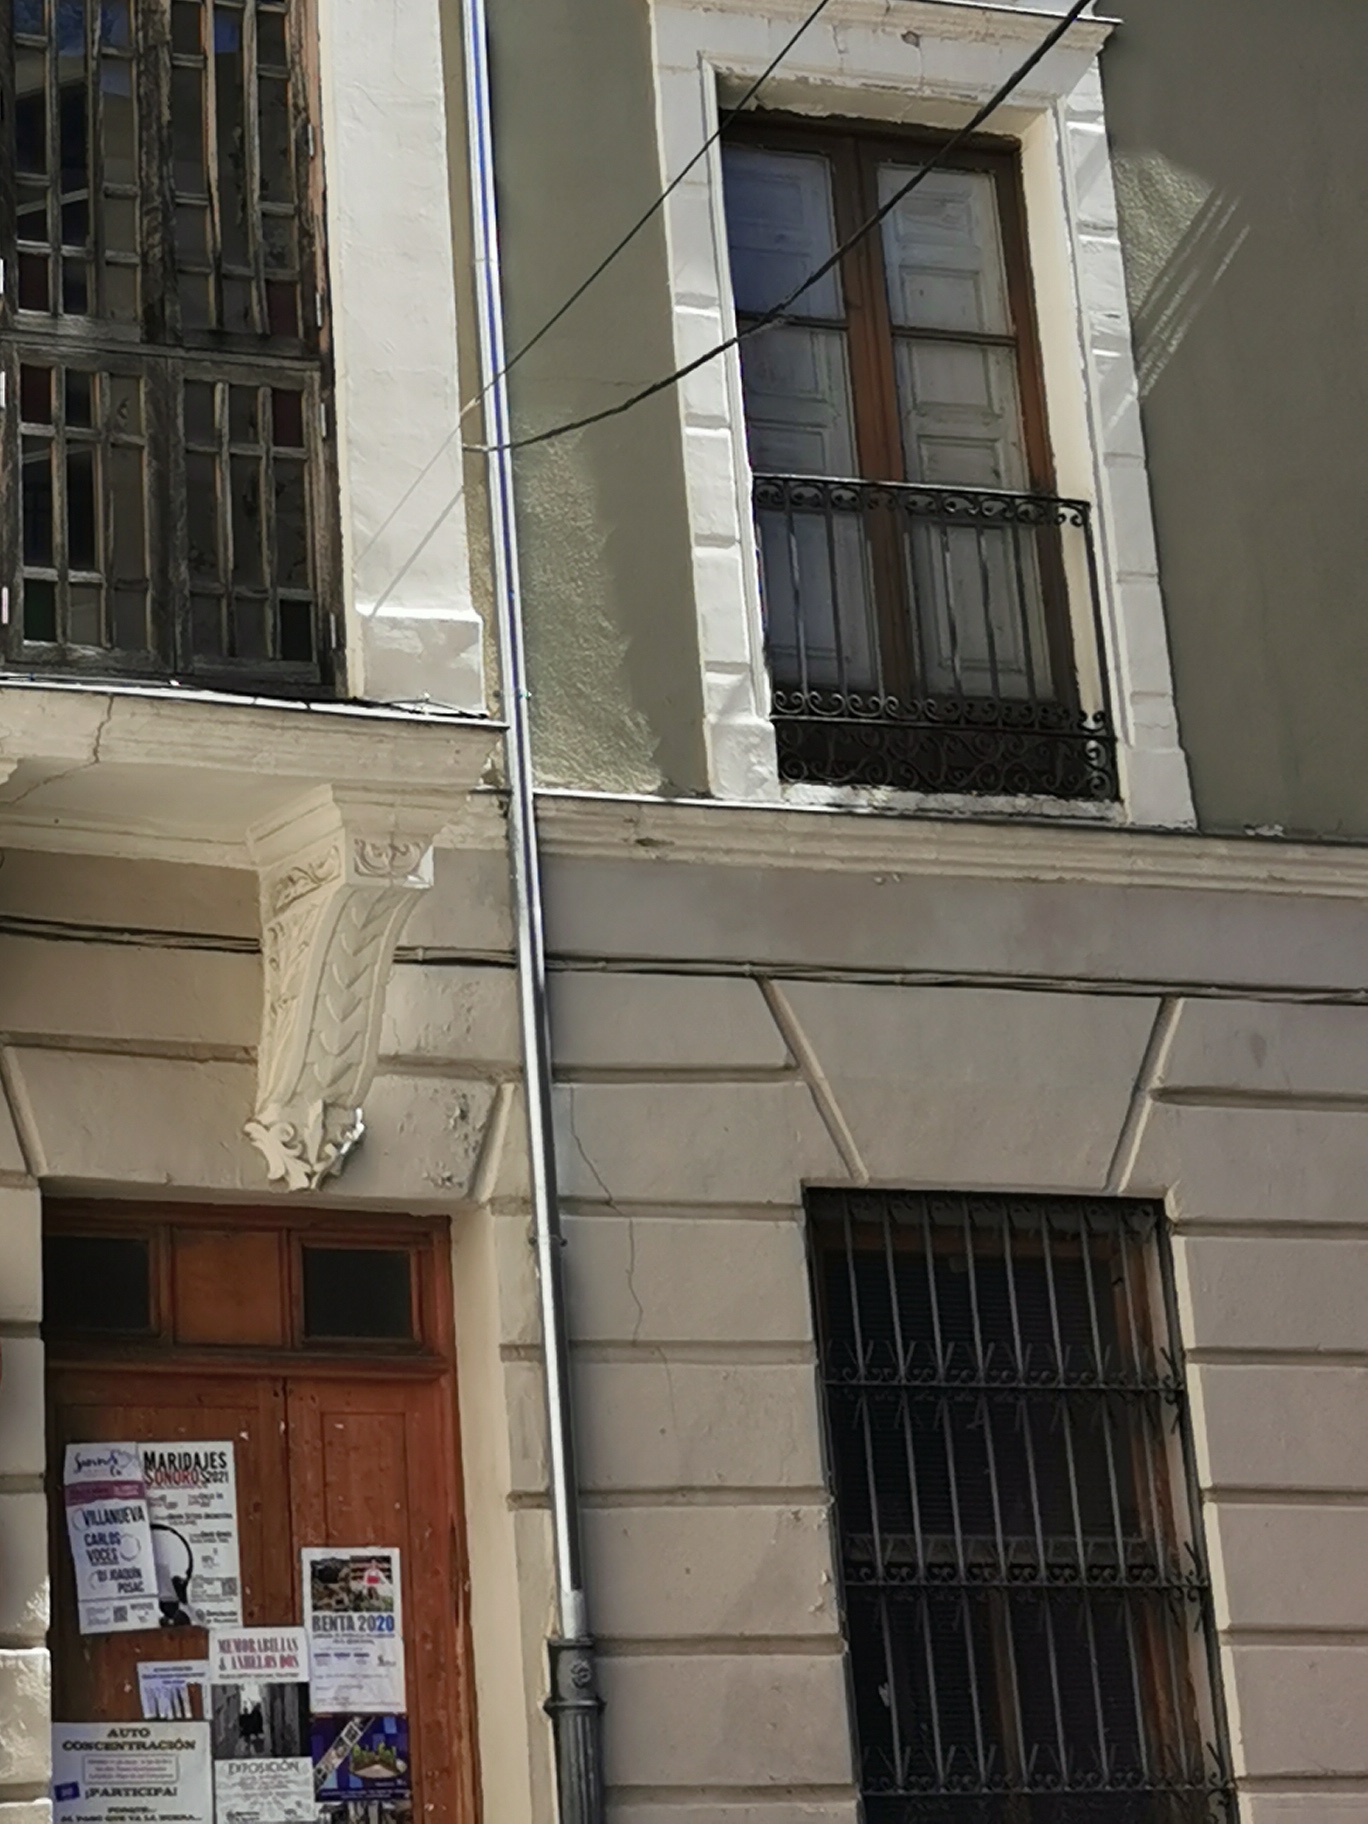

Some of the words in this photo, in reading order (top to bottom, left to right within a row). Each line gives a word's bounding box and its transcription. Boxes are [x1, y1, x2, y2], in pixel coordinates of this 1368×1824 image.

[144, 1451, 227, 1471] MARIDAJES
[144, 1470, 208, 1486] SONOROS
[207, 1471, 229, 1484] 2021
[84, 1506, 146, 1526] VILLANUEVA
[84, 1531, 121, 1547] CARLOS
[312, 1615, 354, 1632] RENTA
[358, 1615, 395, 1632] 2020
[107, 1728, 150, 1738] AUTO
